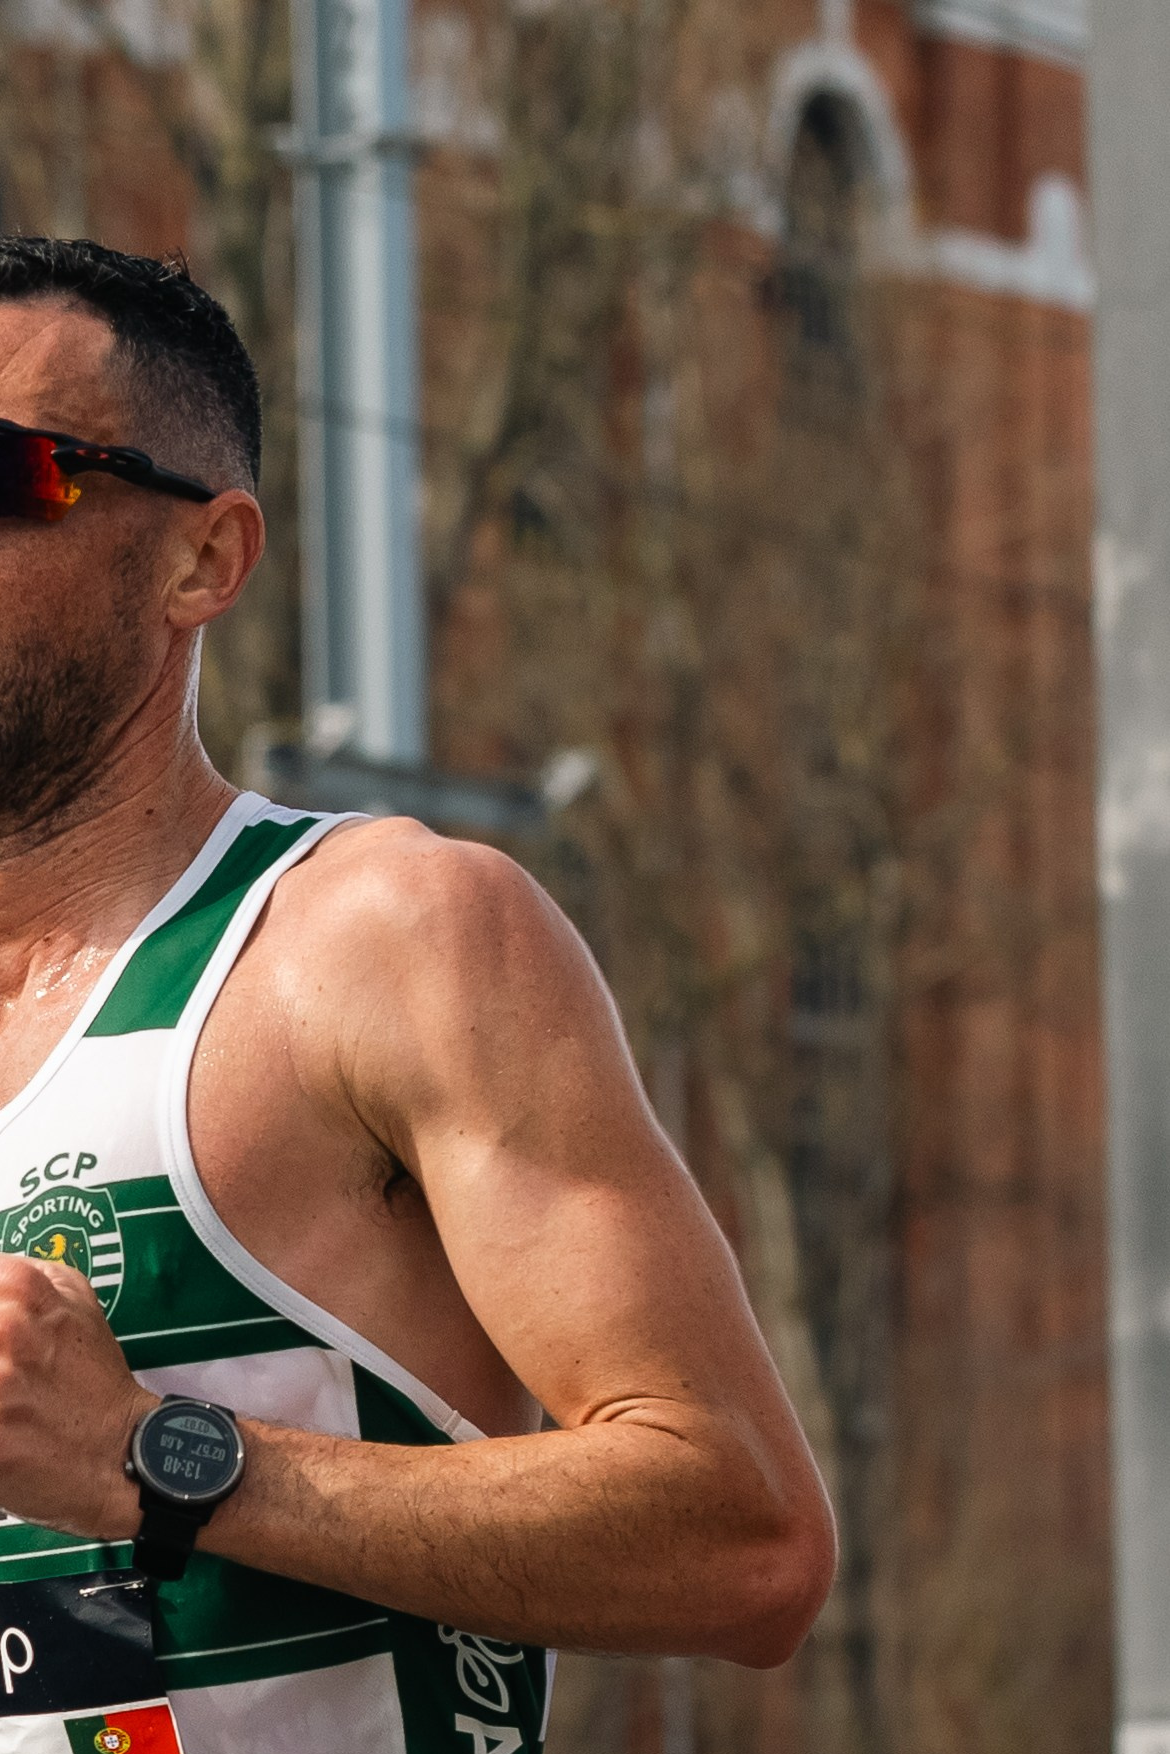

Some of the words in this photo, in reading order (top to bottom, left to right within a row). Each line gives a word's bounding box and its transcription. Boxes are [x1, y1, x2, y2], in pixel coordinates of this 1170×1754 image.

[20, 1152, 98, 1198] SCP
[10, 1196, 105, 1247] SPORTING
[163, 1455, 201, 1480] 13:48
